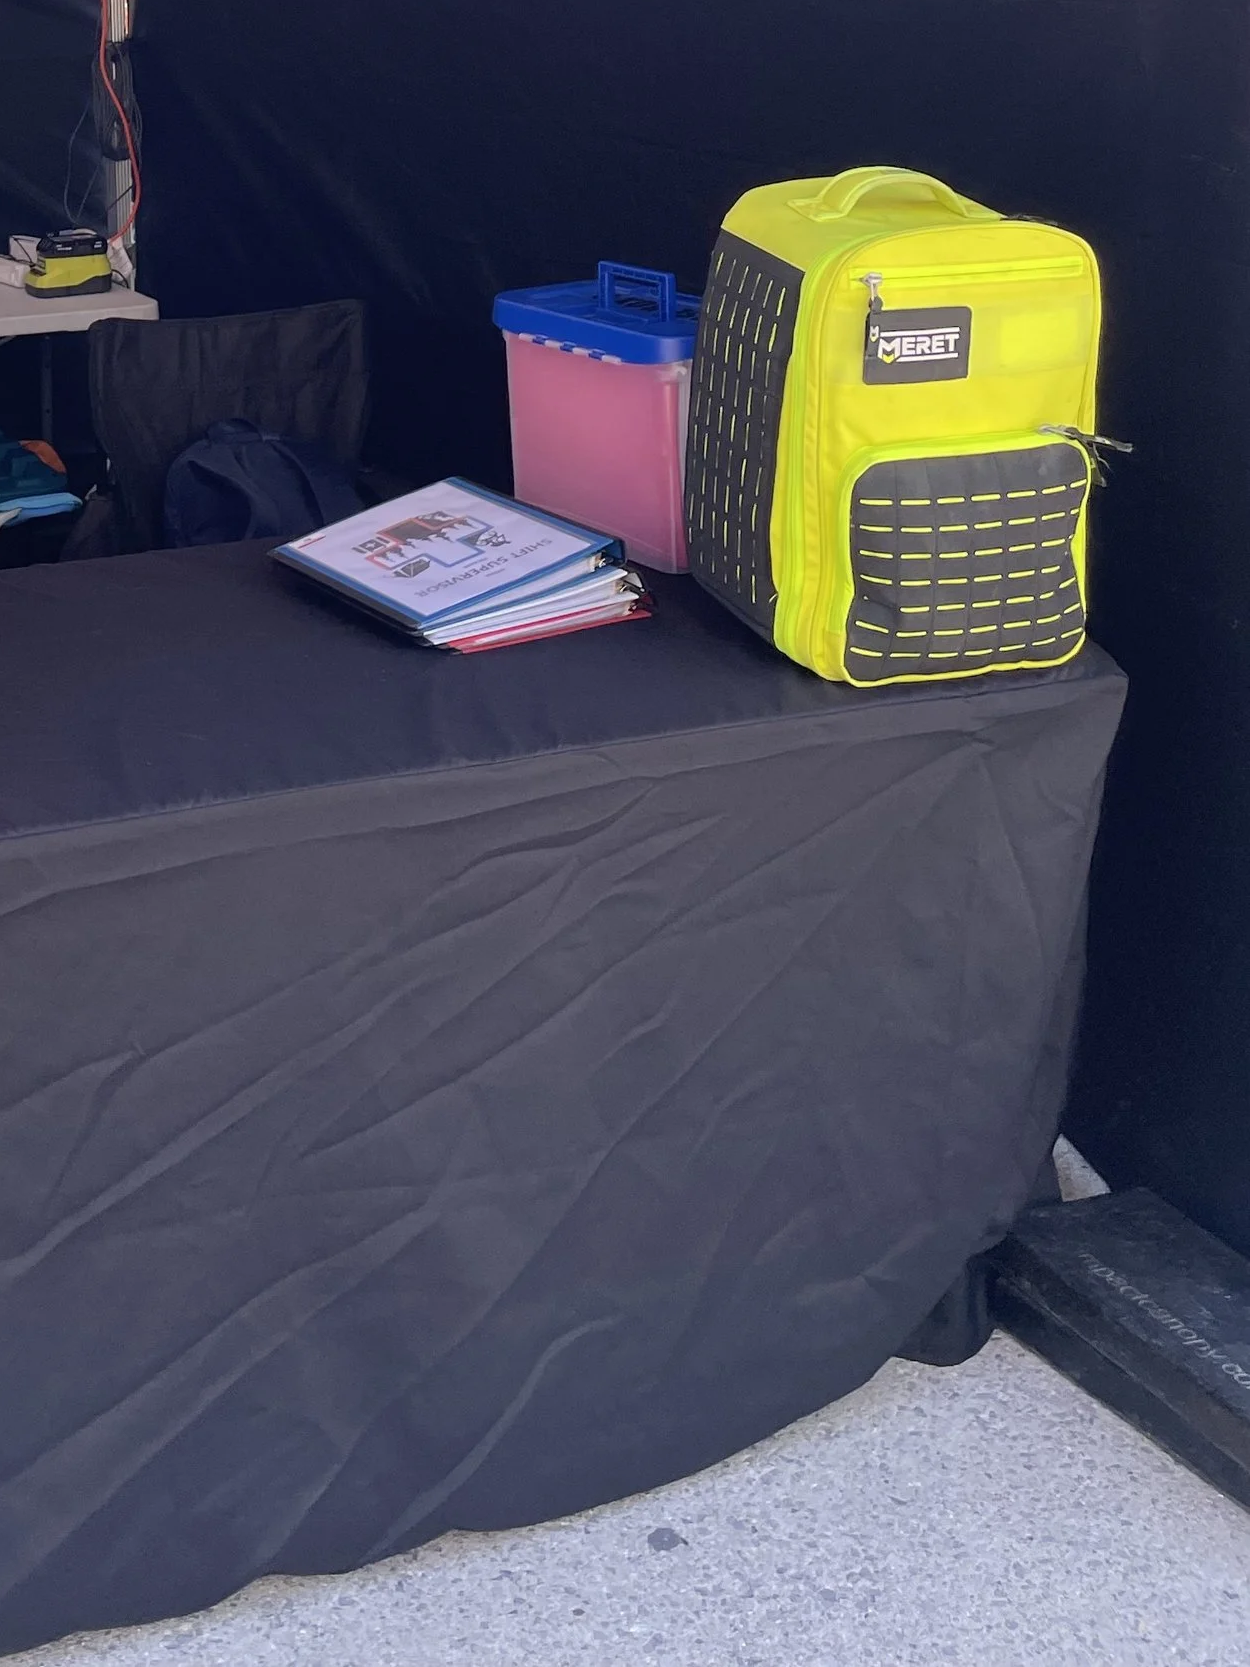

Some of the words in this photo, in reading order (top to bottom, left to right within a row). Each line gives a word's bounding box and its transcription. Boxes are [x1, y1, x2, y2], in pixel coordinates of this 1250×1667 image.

[877, 332, 961, 364] MERET
[510, 537, 553, 559] SHIFT
[413, 556, 510, 599] SUPERVISOR
